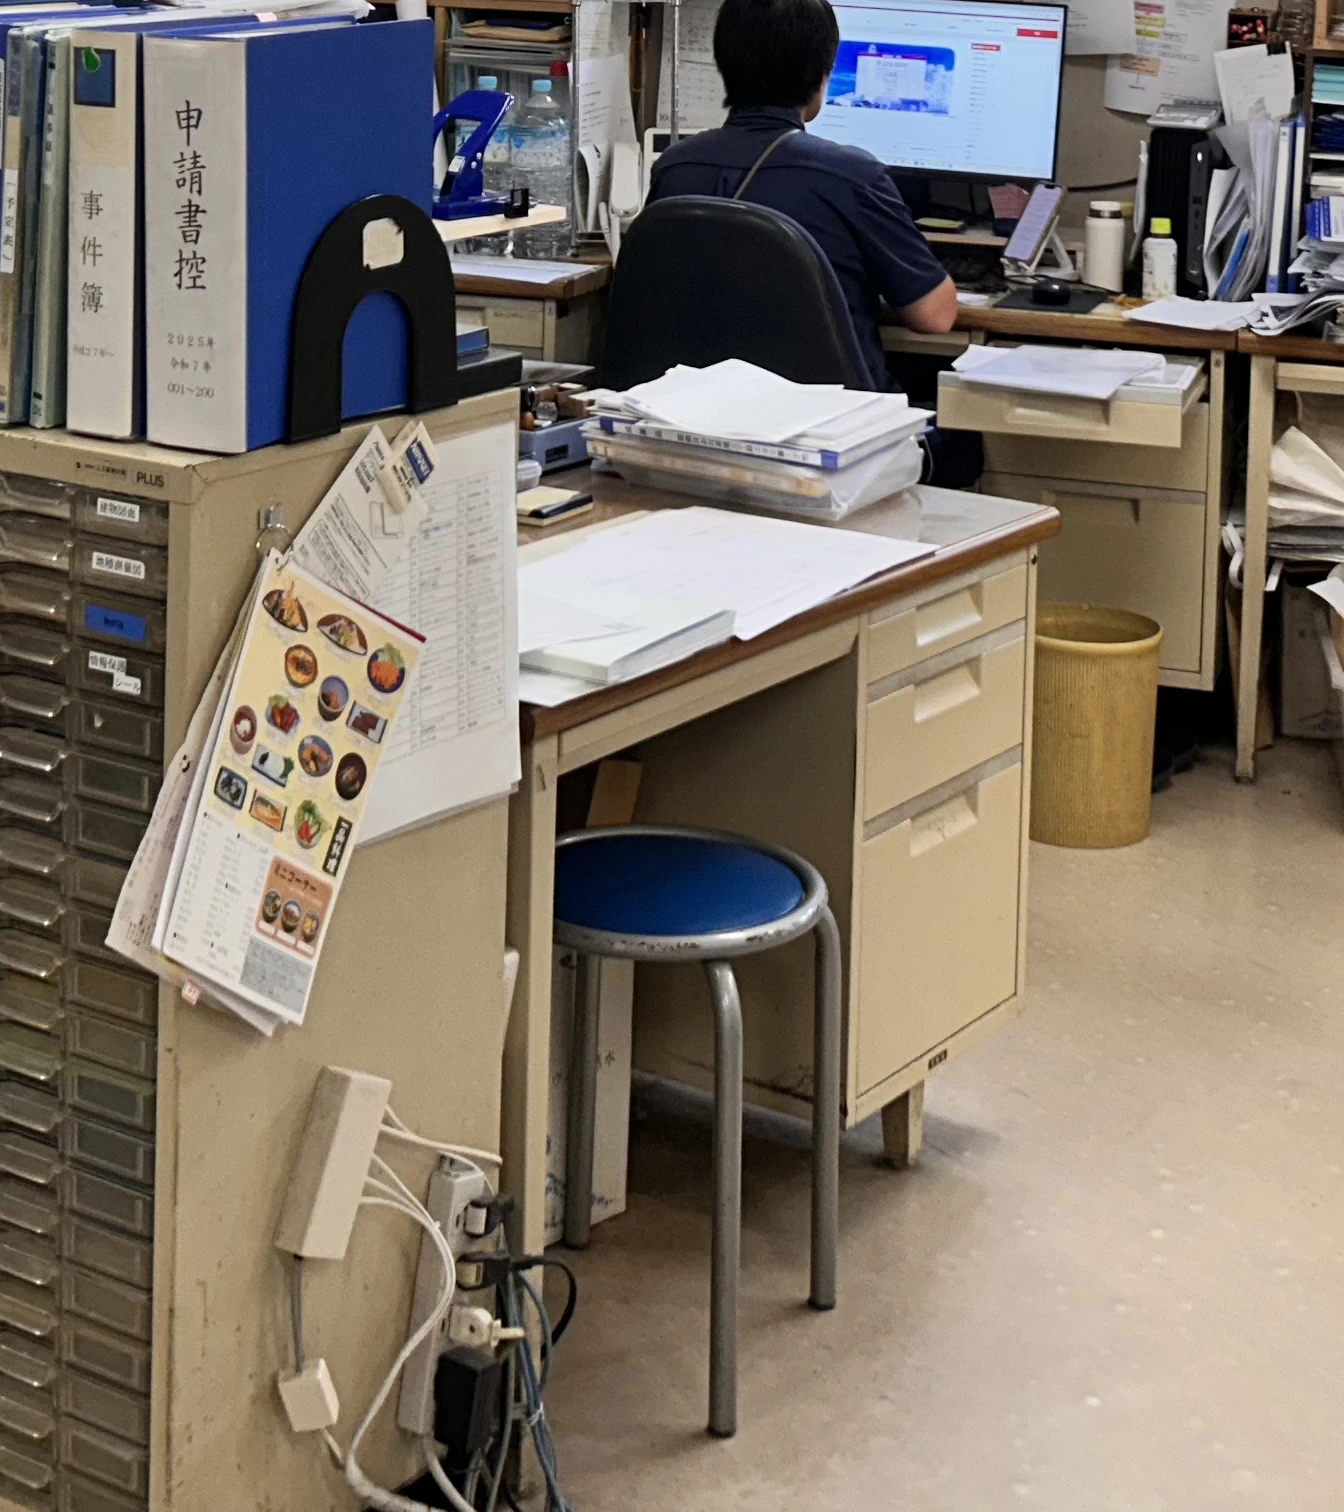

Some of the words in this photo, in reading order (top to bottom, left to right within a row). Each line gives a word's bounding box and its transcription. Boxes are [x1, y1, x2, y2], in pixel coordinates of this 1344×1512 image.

[80, 189, 104, 314] 事件簿
[172, 99, 207, 291] 申請書控
[136, 471, 165, 488] PLUS
